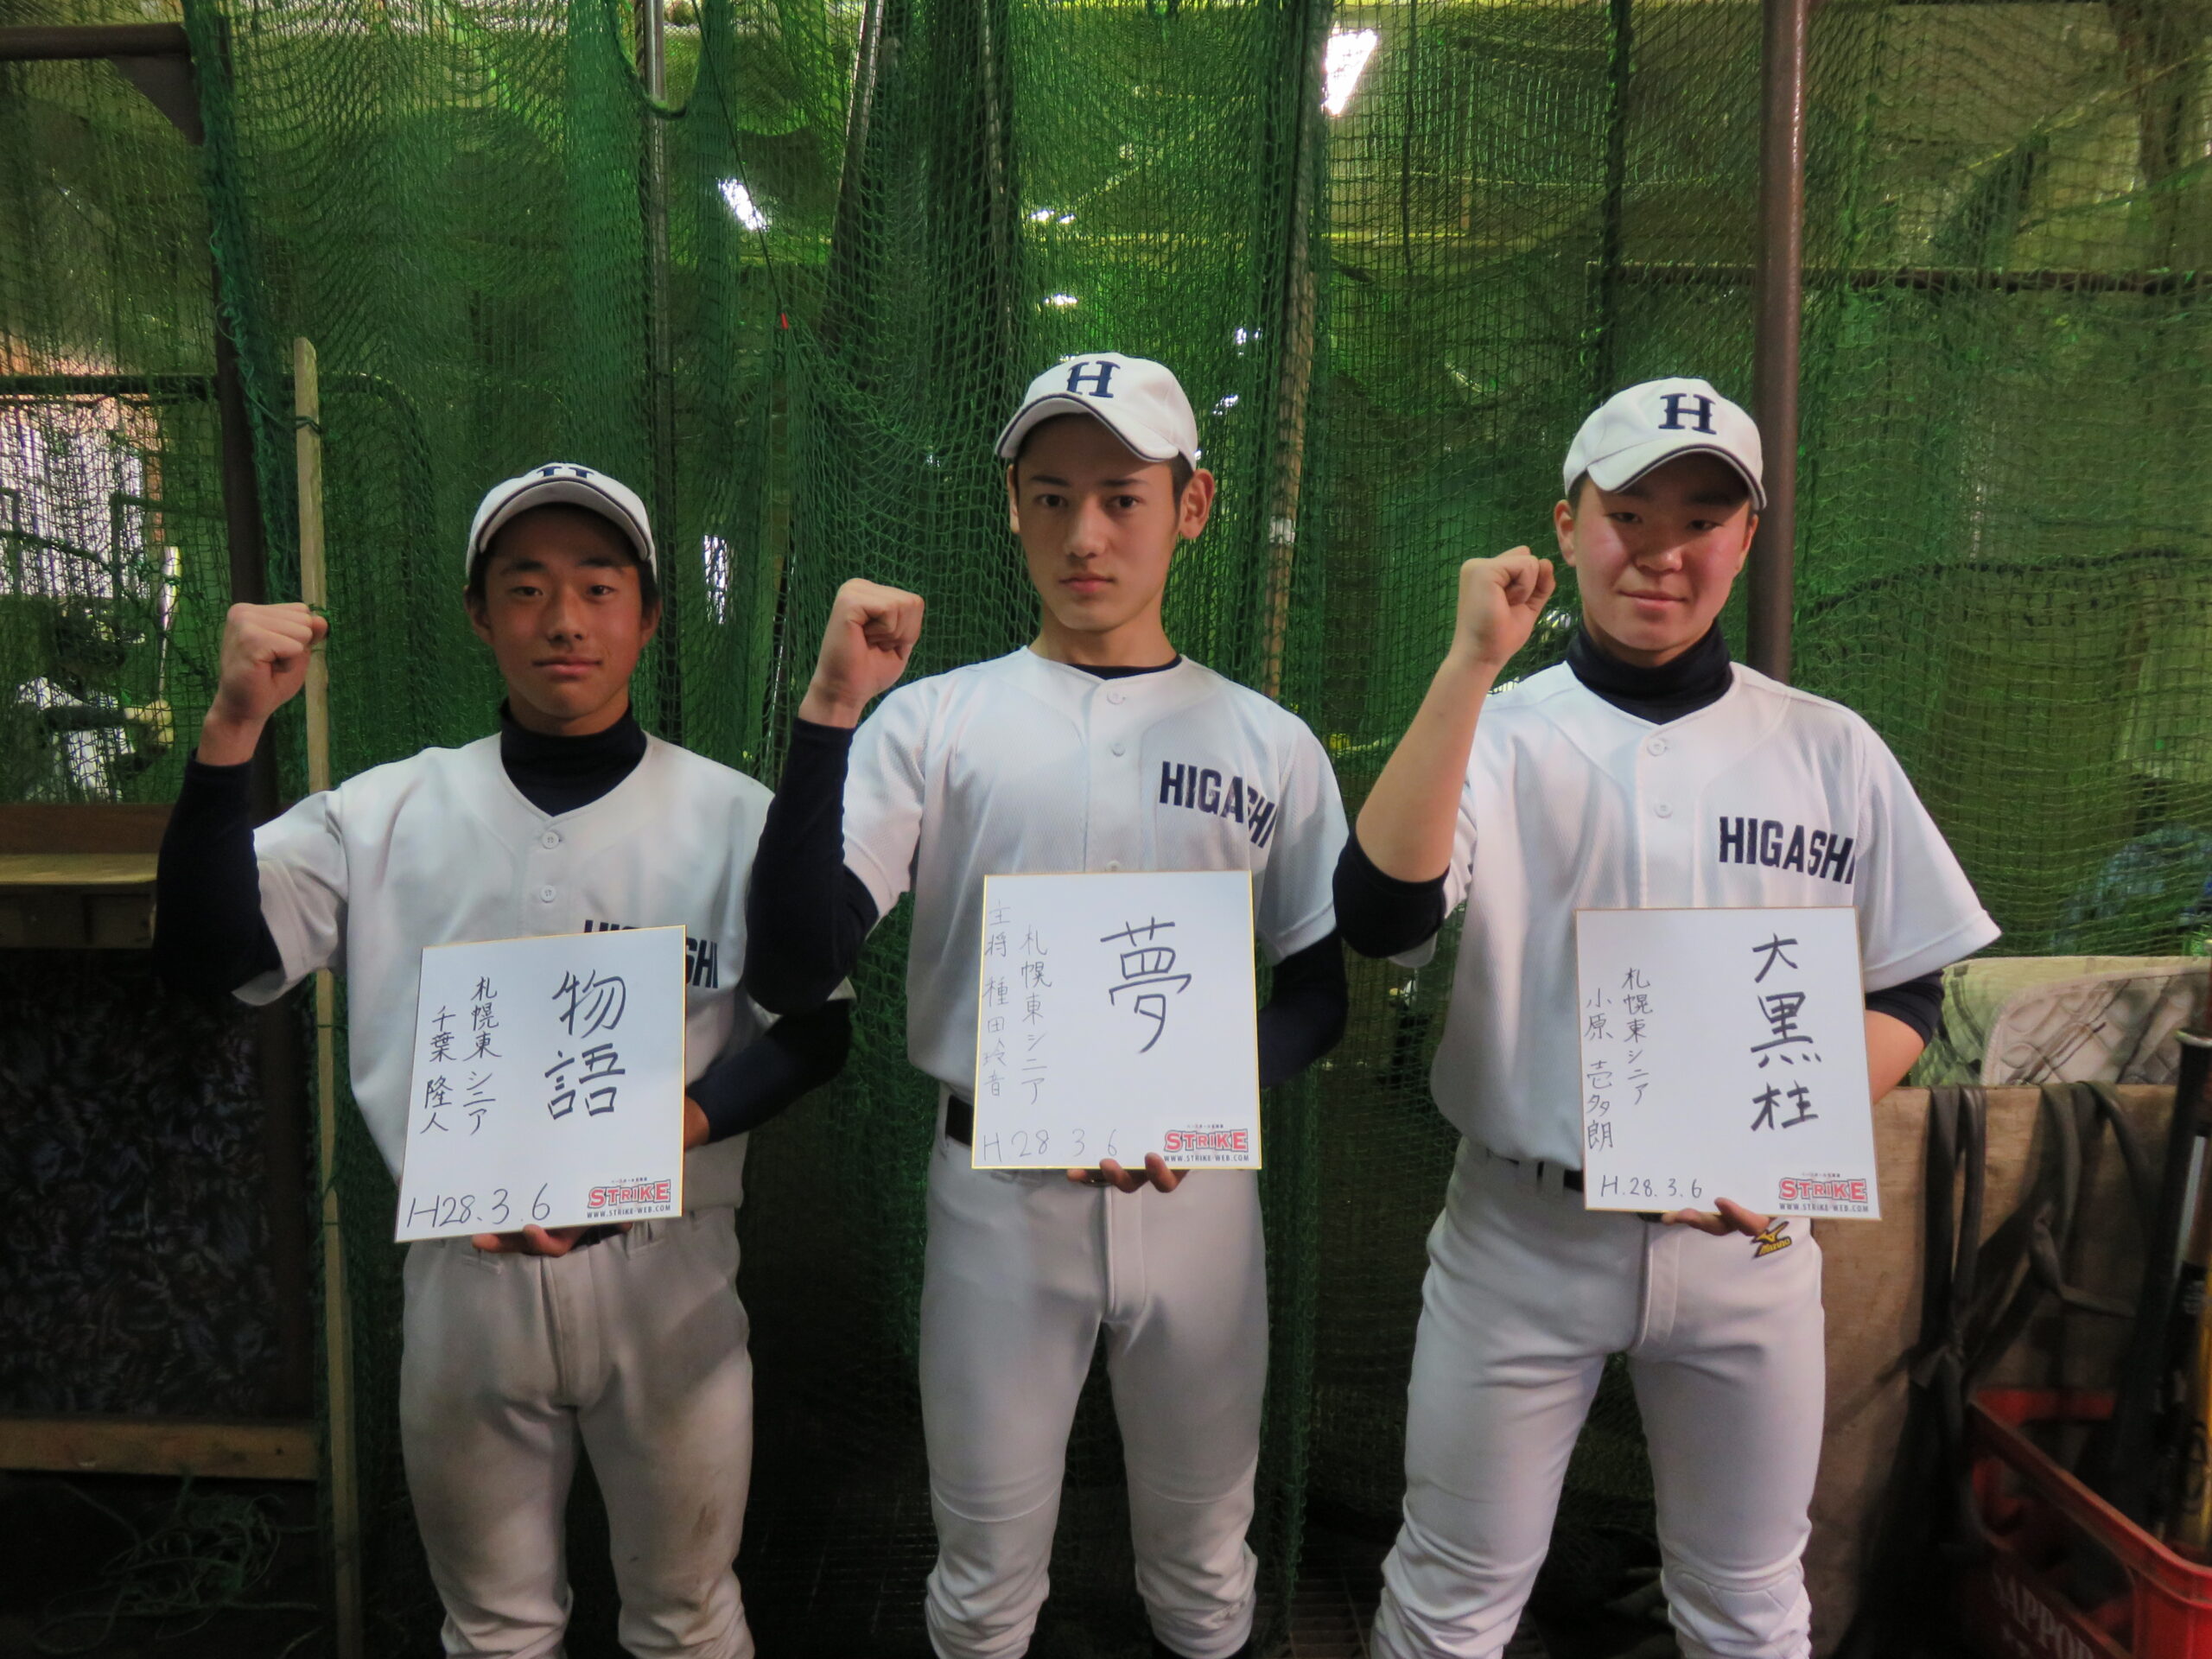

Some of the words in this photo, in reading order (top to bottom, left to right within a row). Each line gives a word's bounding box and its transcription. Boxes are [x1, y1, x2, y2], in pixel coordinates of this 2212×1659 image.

[1067, 360, 1121, 398] H
[1658, 393, 1717, 435] H
[1100, 916, 1192, 1054] 夢
[544, 969, 626, 1120] 物語
[1751, 932, 1821, 1132] 大黒柱
[1164, 1129, 1249, 1153] STRIKE
[588, 1179, 671, 1209] STRIKE
[1779, 1177, 1867, 1203] STRIKE
